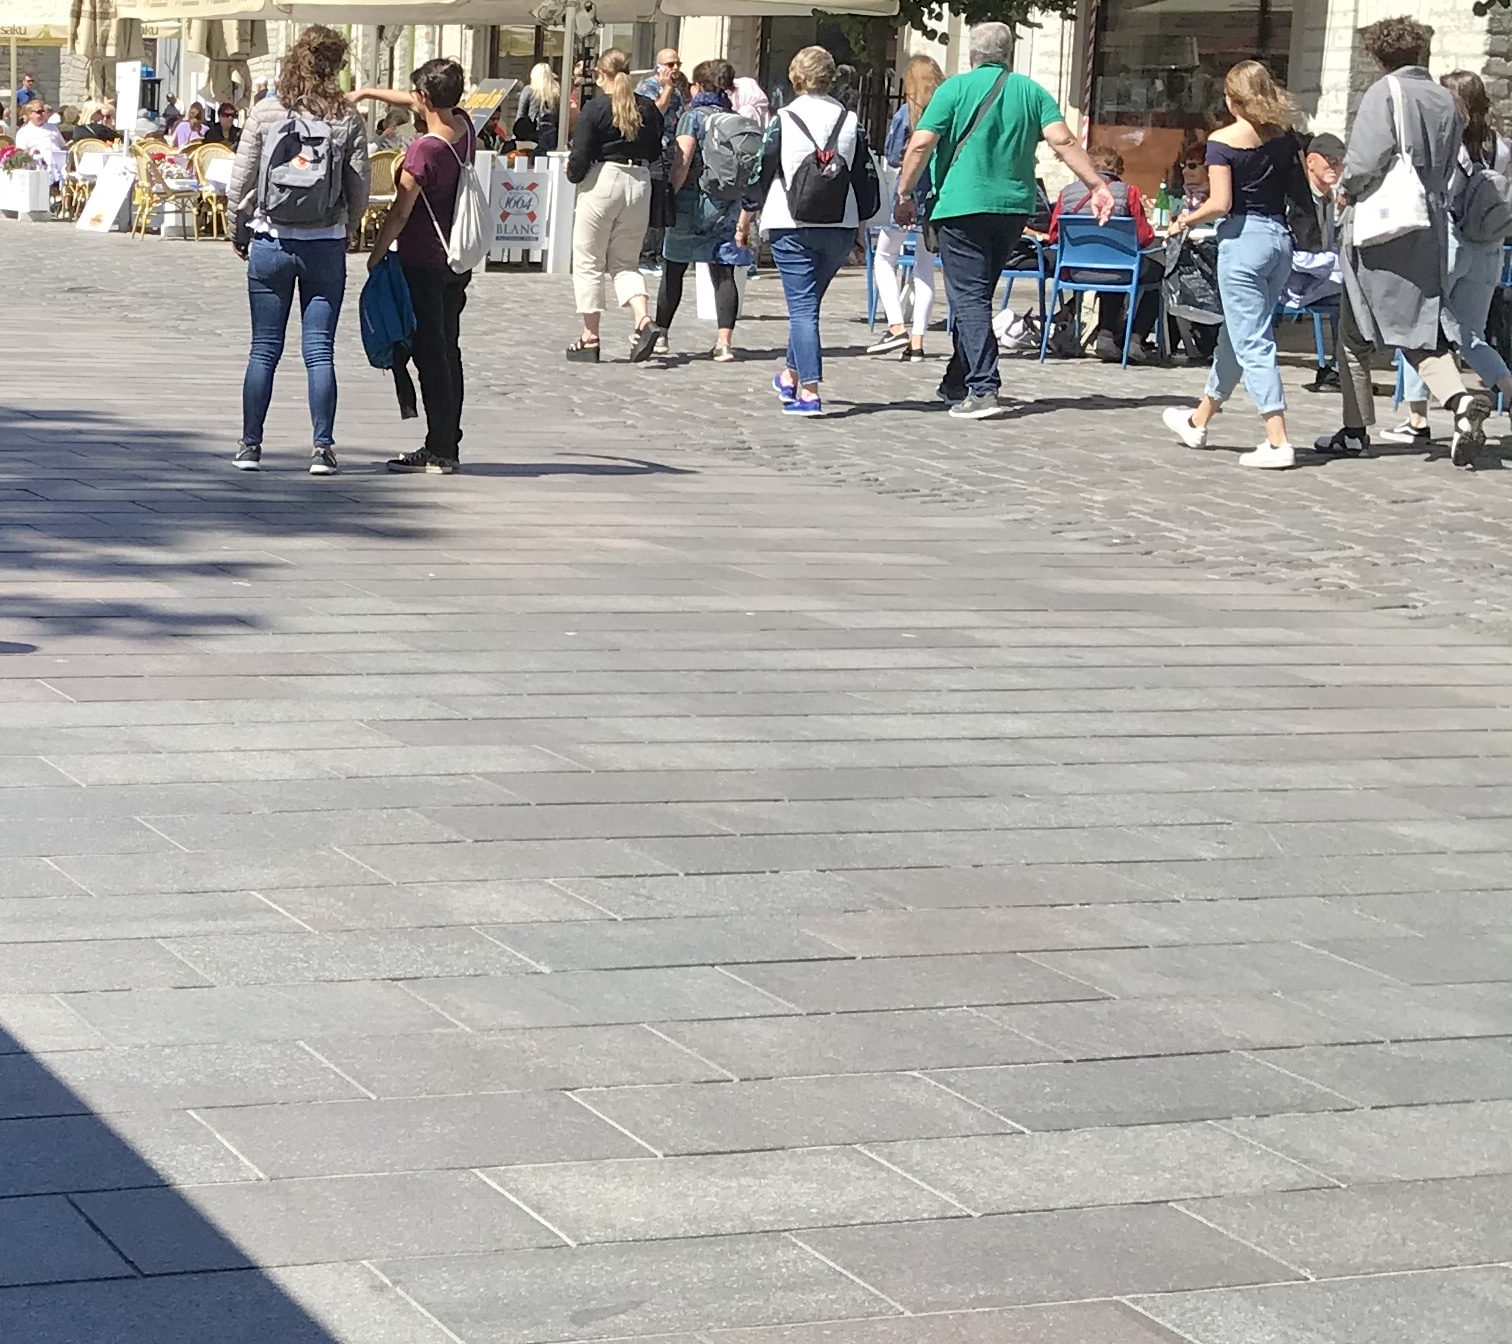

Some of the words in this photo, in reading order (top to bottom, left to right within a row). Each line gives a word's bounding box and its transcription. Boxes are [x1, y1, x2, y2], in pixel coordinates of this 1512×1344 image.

[0, 24, 28, 36] saku
[139, 25, 159, 36] aku
[504, 196, 533, 210] 1664
[496, 224, 540, 235] BLANC
